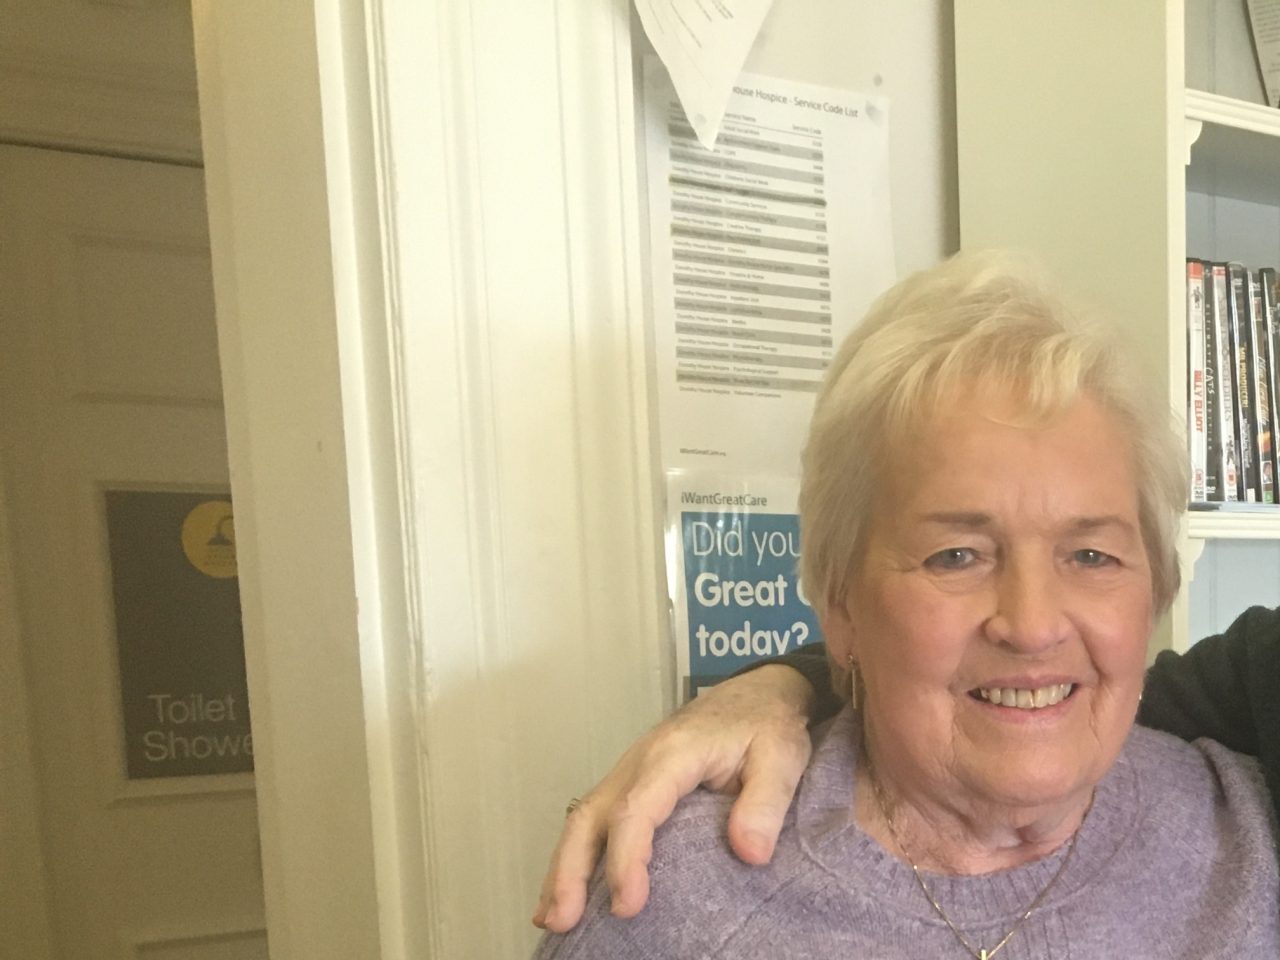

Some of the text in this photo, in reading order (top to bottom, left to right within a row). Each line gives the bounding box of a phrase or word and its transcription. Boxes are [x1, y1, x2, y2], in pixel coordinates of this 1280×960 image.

[755, 89, 788, 104] Hospice
[794, 97, 822, 111] Service
[822, 103, 844, 115] Code
[844, 107, 859, 118] List
[1204, 367, 1216, 395] CATS
[1193, 369, 1204, 433] BILLY ELLIOT
[681, 491, 768, 507] iWantGreatCare
[691, 520, 743, 557] Did
[694, 572, 788, 608] Great
[695, 620, 810, 657] today?
[147, 693, 237, 725] Toilet
